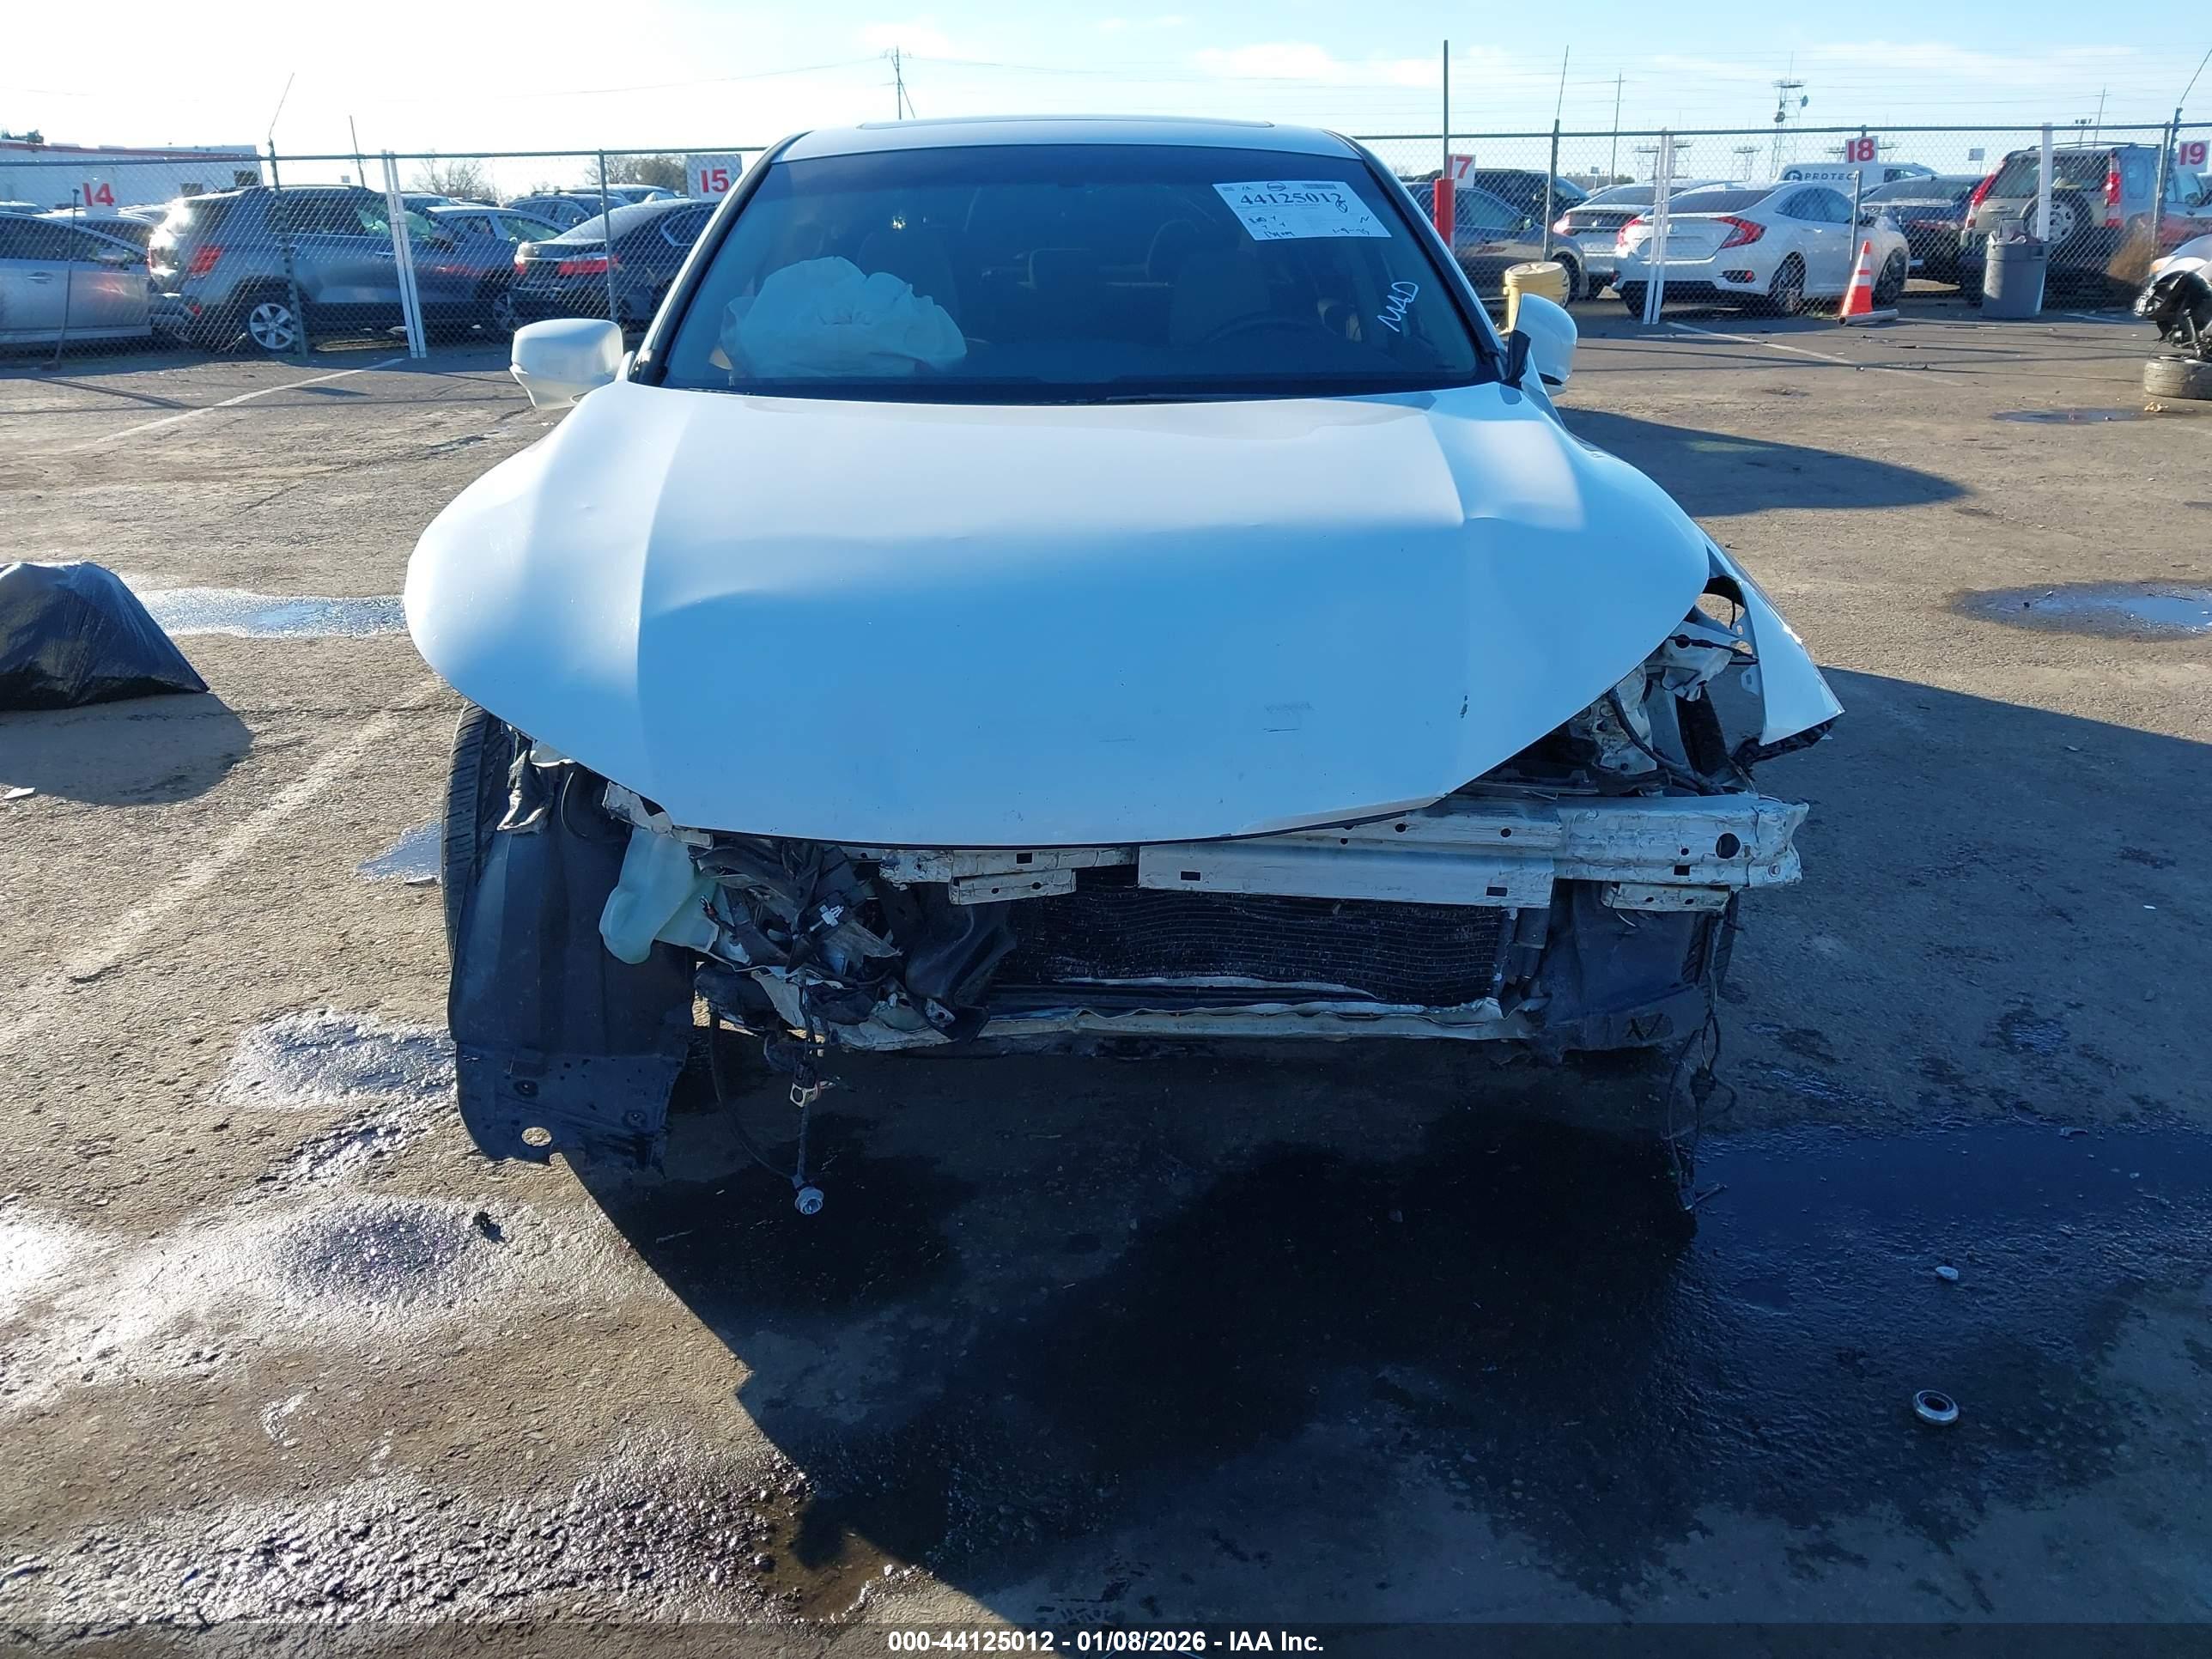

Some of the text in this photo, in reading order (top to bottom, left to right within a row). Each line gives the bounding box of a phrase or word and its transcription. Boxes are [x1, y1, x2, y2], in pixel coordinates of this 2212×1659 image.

[1848, 138, 1875, 163] 18
[2180, 143, 2206, 165] 19
[701, 169, 728, 192] 15
[82, 183, 114, 206] 14
[1240, 192, 1346, 205] 44125012
